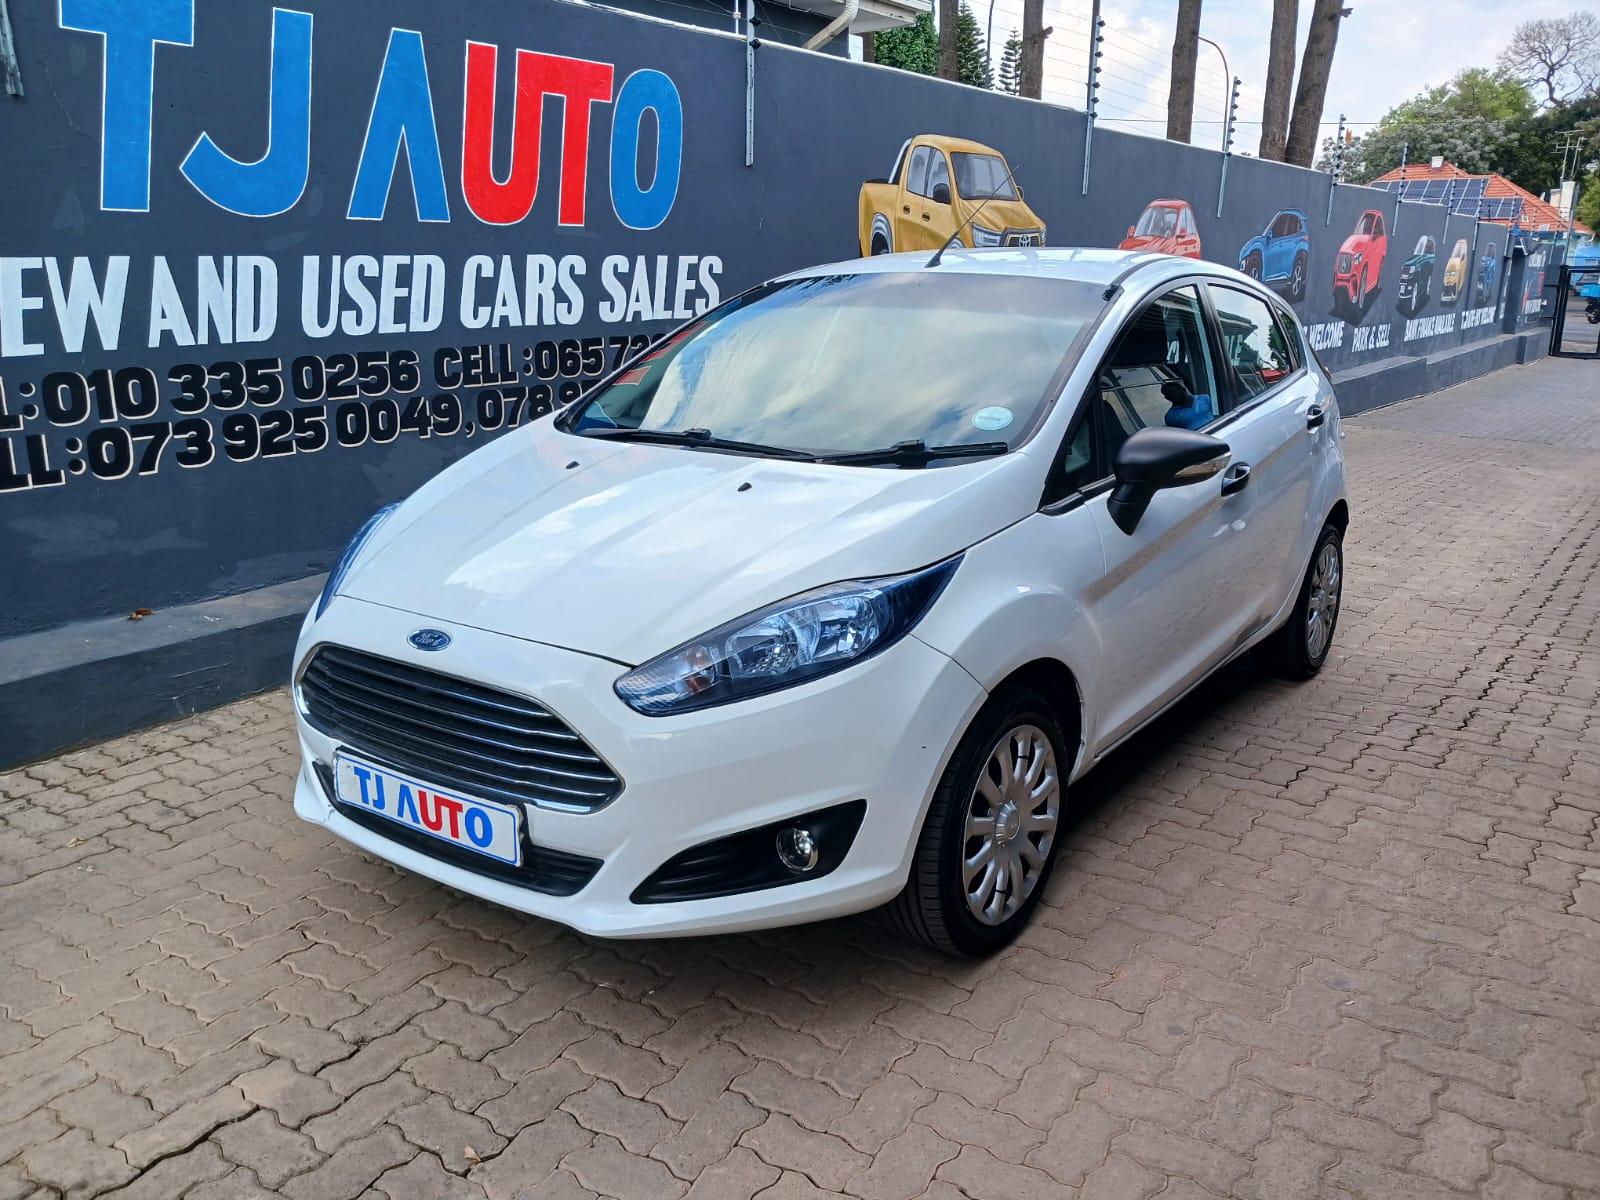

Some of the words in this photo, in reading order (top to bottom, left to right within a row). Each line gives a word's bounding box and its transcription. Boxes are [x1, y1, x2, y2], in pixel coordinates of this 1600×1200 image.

[58, 0, 314, 218] TJ
[346, 27, 684, 231] AUTO
[148, 255, 278, 348] AND
[302, 254, 446, 336] USED
[461, 254, 588, 329] CARS
[599, 254, 723, 320] SALES
[1309, 321, 1346, 351] WELCOME
[1352, 326, 1371, 352] PARK
[1376, 323, 1391, 348] SELL
[168, 357, 285, 415] 335
[291, 349, 421, 402] 0256
[222, 404, 329, 463] 925
[354, 766, 386, 811] TJ
[397, 784, 493, 848] AUTO
